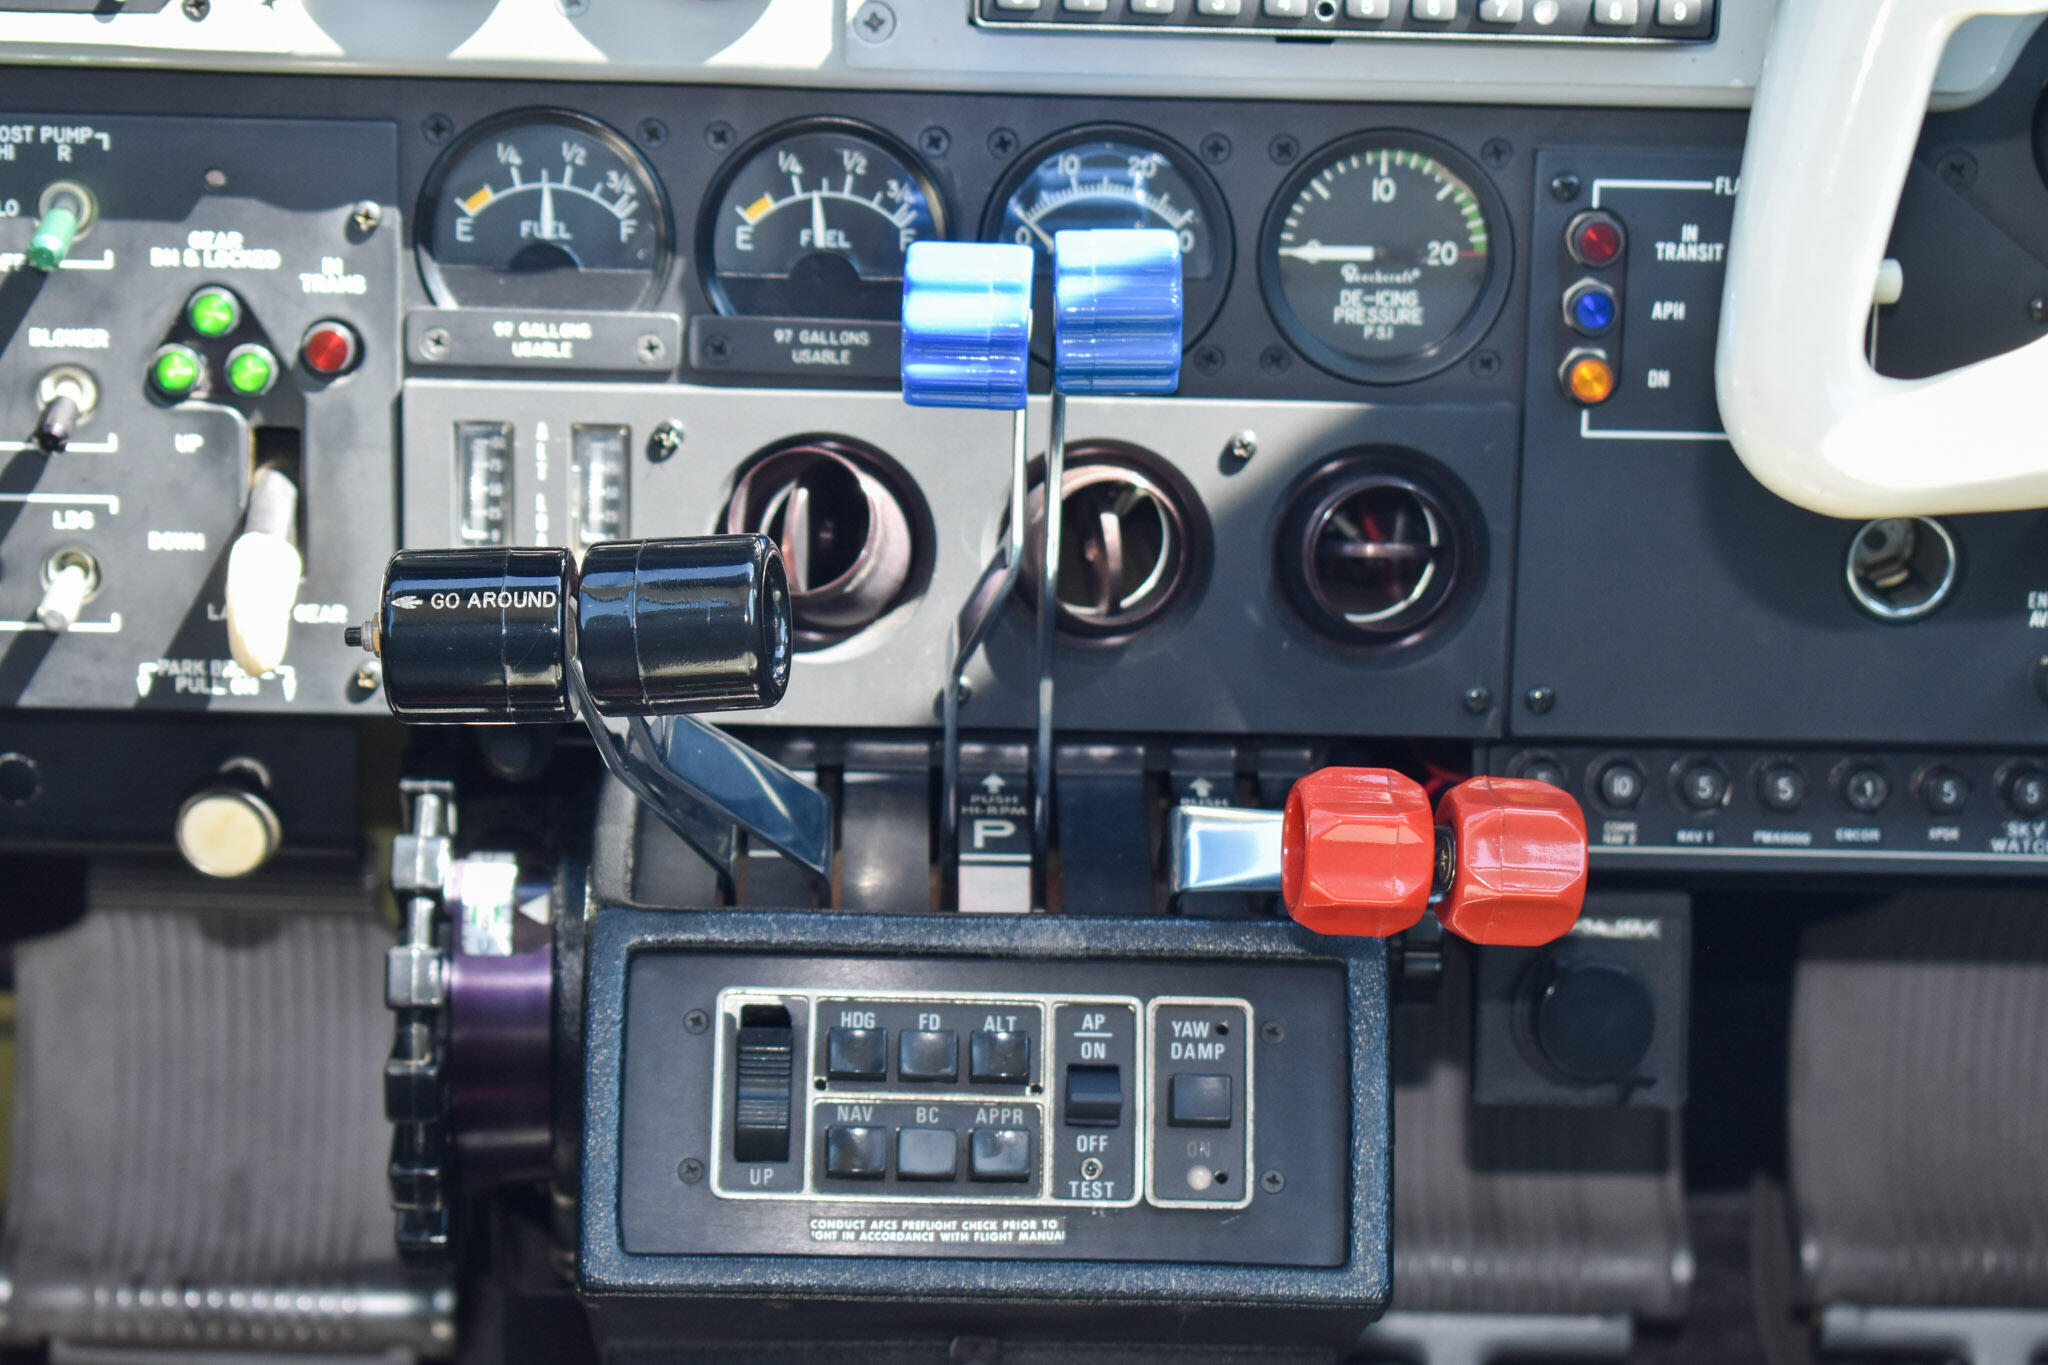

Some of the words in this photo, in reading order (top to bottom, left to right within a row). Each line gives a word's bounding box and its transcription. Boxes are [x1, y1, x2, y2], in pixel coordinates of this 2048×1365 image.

[1609, 2, 1622, 20] 8
[1674, 3, 1687, 20] 9
[40, 126, 94, 144] PUMP
[57, 144, 72, 161] R
[497, 141, 522, 166] 1/4
[562, 141, 587, 166] 1/2
[778, 150, 804, 174] 1/4
[843, 150, 868, 175] 1/2
[1058, 154, 1080, 176] 10
[606, 170, 637, 195] 3/4
[1372, 177, 1397, 202] 10
[455, 217, 475, 242] E
[620, 219, 639, 243] F
[735, 225, 755, 250] E
[800, 228, 851, 249] FEL
[1681, 223, 1699, 242] IN
[188, 231, 244, 249] GEAR
[900, 228, 917, 252] F
[204, 249, 281, 269] LOCKED
[1427, 240, 1459, 266] 20
[1655, 241, 1724, 262] TRANSIT
[322, 257, 343, 275] IN
[300, 273, 367, 294] TRANS
[1339, 289, 1419, 307] DE-ICING
[1333, 306, 1424, 325] PRESSURE
[1651, 301, 1686, 321] APH
[518, 322, 592, 340] GALLONS
[774, 328, 794, 344] 97
[799, 329, 871, 346] GALLONS
[511, 341, 573, 359] USABLE
[792, 349, 851, 365] USABLE
[1647, 369, 1671, 389] DN
[175, 434, 205, 453] UP
[148, 531, 206, 551] DOWN
[431, 592, 460, 610] GO
[467, 591, 557, 609] AROUND
[293, 603, 348, 623] GEAR
[157, 658, 207, 677] PARK
[175, 676, 227, 695] PULL
[230, 677, 260, 696] ON
[1613, 776, 1633, 797] 10
[1697, 775, 1713, 799] 5
[1777, 776, 1794, 800] 5
[1942, 780, 1957, 804] 5
[2026, 782, 2041, 804] 5
[973, 819, 1016, 849] P
[841, 1011, 876, 1029] HDG
[918, 1014, 941, 1030] FD
[983, 1016, 1017, 1032] ALT
[1082, 1014, 1105, 1030] AP
[1172, 1021, 1210, 1038] YAW
[1080, 1042, 1106, 1059] ON
[1170, 1043, 1226, 1060] DAMP
[837, 1106, 873, 1121] NAV
[916, 1107, 940, 1123] BC
[975, 1108, 1024, 1125] APPR
[1076, 1135, 1109, 1152] OFF
[750, 1169, 775, 1186] UP
[1068, 1181, 1115, 1198] TEST
[810, 1219, 866, 1230] CONDUCT
[870, 1220, 898, 1231] AFCS
[902, 1220, 957, 1231] PREFLIGHT
[961, 1220, 998, 1231] CHECK
[1003, 1220, 1037, 1231] PRIOR
[1041, 1220, 1058, 1230] TO
[811, 1231, 837, 1241] GHT
[842, 1231, 855, 1241] IN
[859, 1231, 935, 1242] ACCORDANCE
[940, 1232, 969, 1242] WITH
[974, 1232, 1014, 1242] FLIGHT
